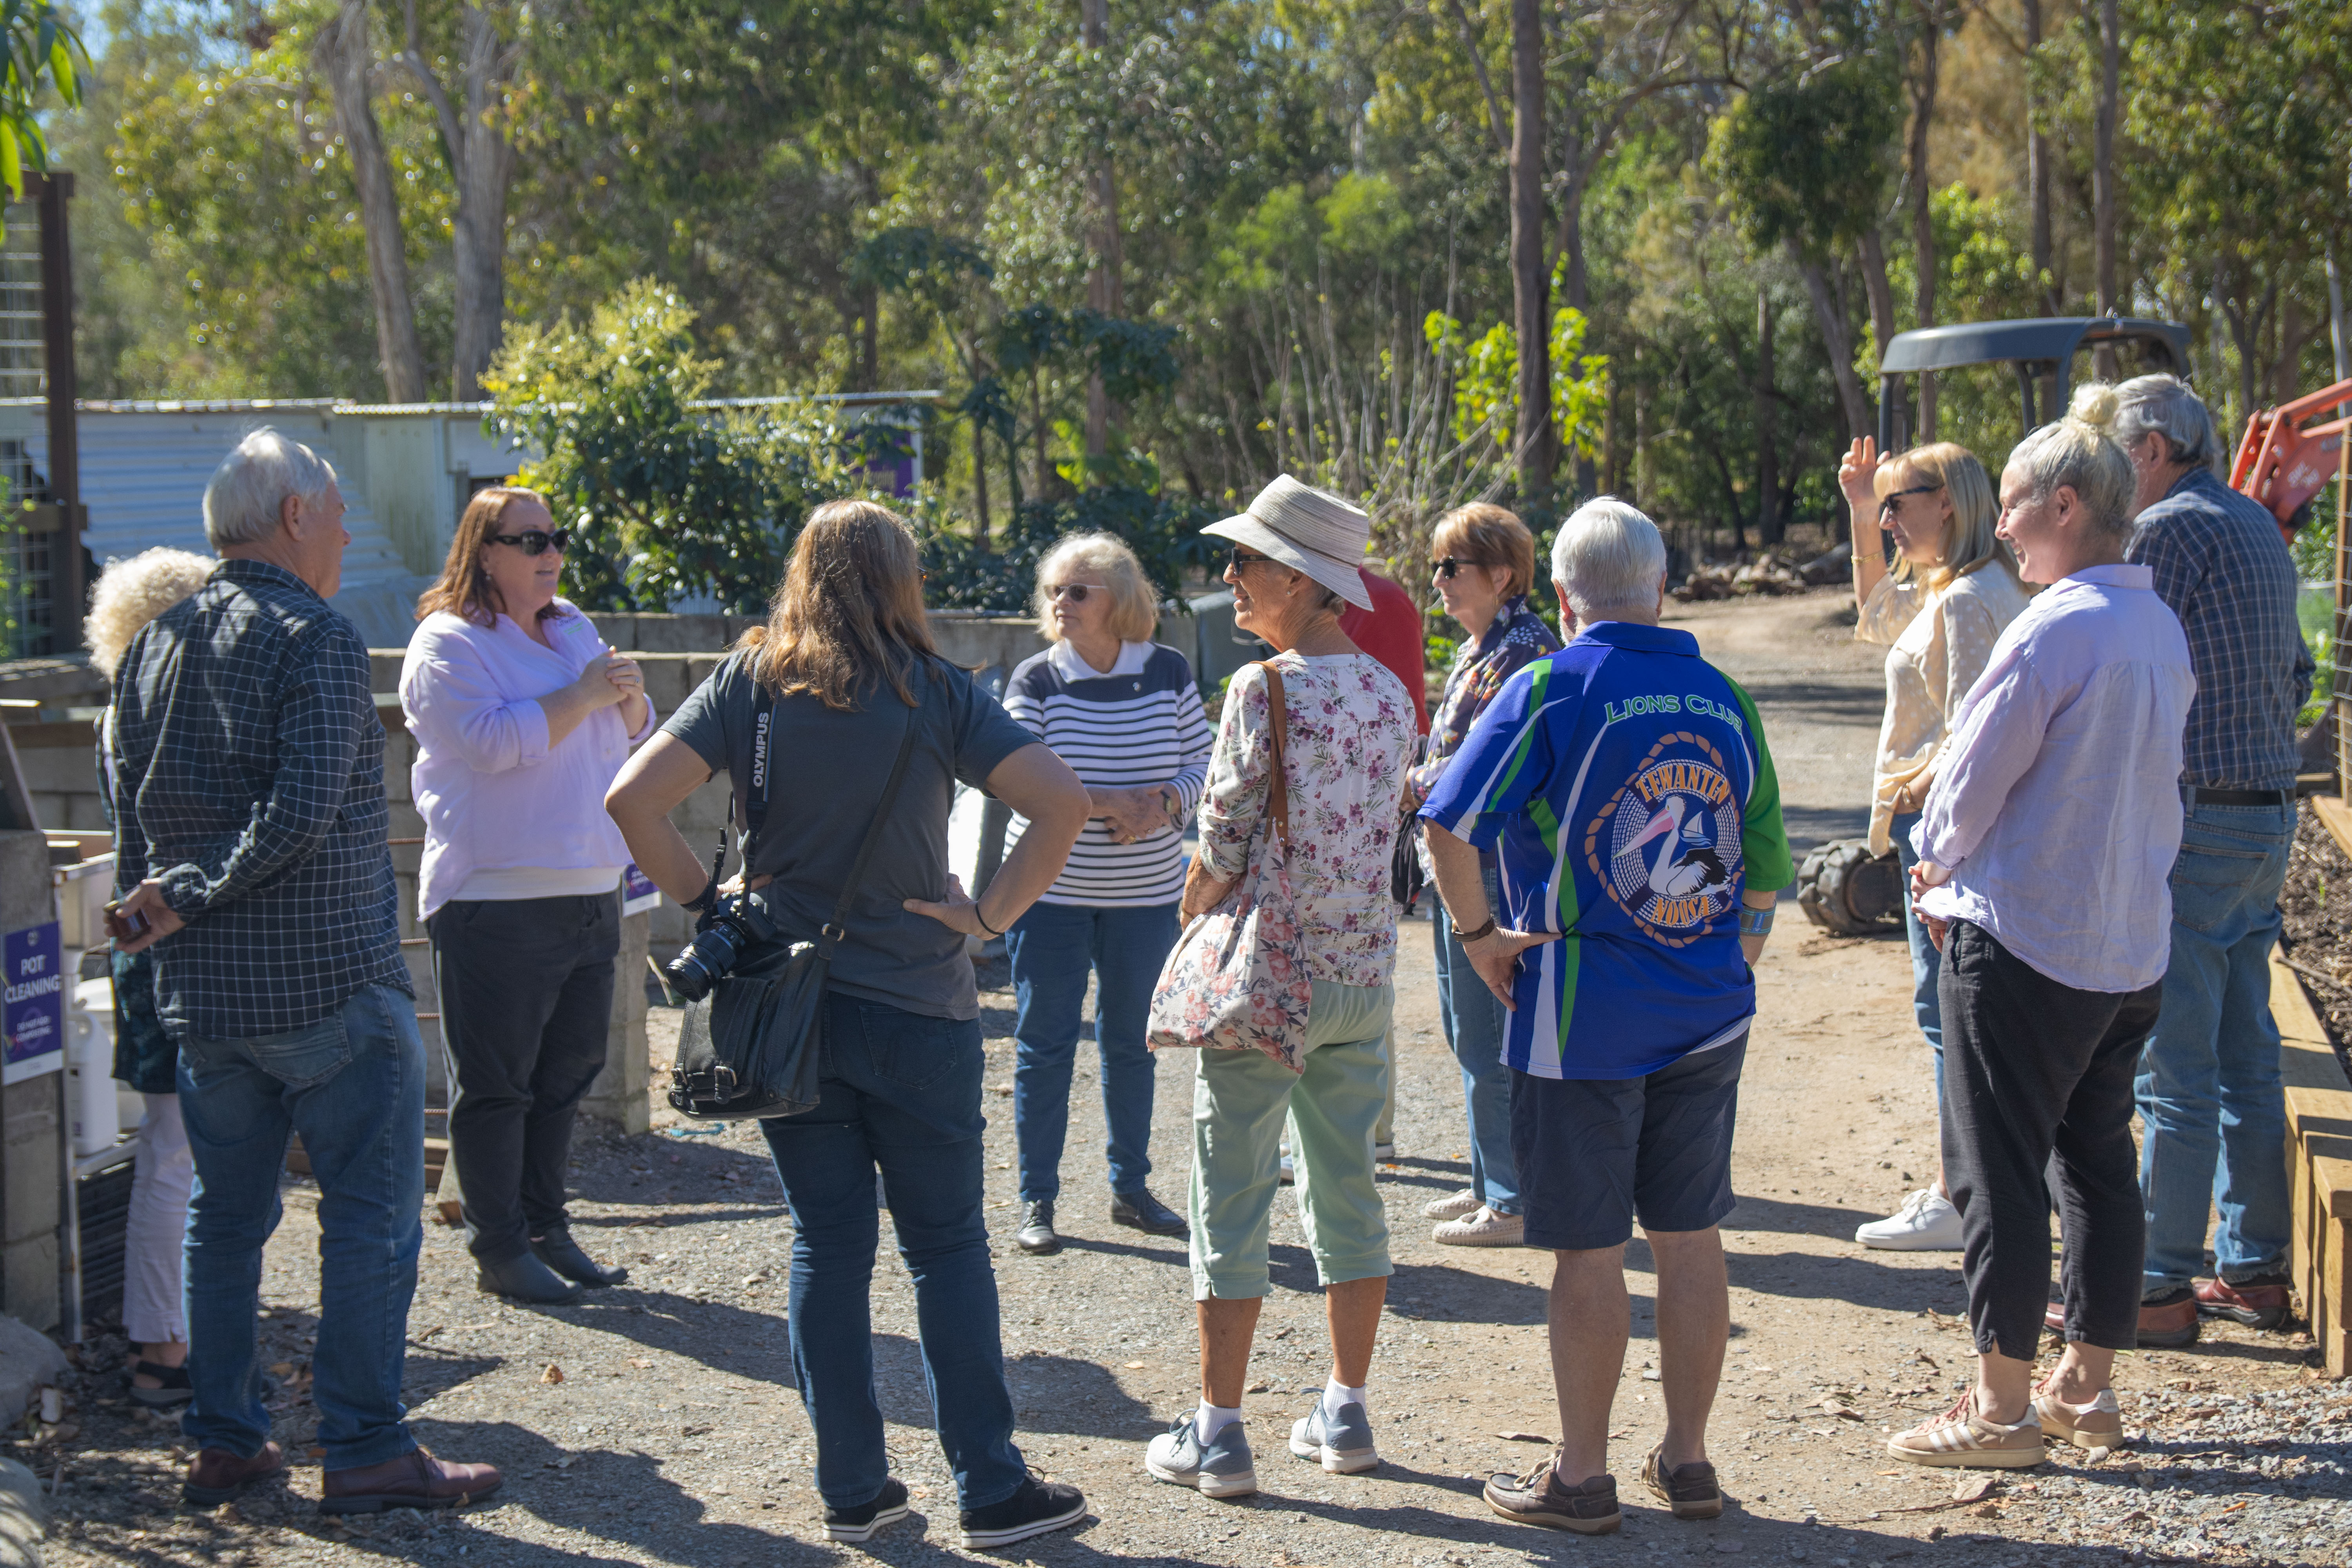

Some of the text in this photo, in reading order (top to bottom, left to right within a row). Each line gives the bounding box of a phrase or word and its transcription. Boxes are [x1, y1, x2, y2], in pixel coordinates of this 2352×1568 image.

[753, 712, 769, 787] OLYMPUS
[1635, 764, 1729, 804] TEWANTIN
[1650, 896, 1710, 925] NOOSA
[21, 954, 45, 976] POT
[4, 974, 61, 1004] CLEANING
